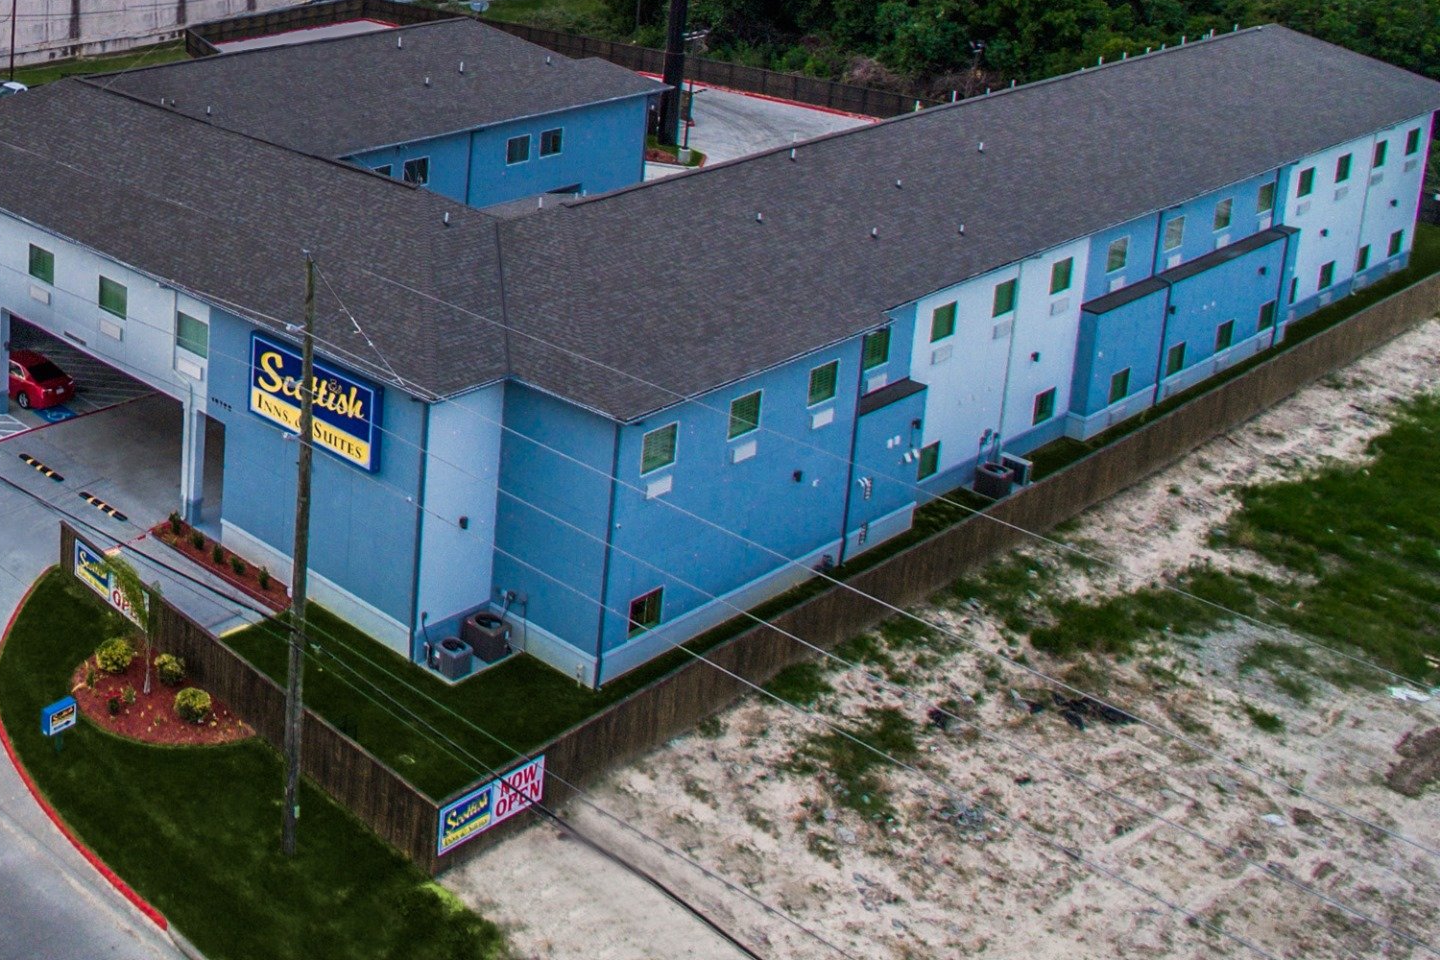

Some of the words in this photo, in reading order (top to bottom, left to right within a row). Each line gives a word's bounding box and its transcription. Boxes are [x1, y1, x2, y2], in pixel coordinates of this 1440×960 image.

[314, 422, 362, 459] SUITES
[500, 762, 538, 797] NOW
[496, 780, 540, 817] OPEN
